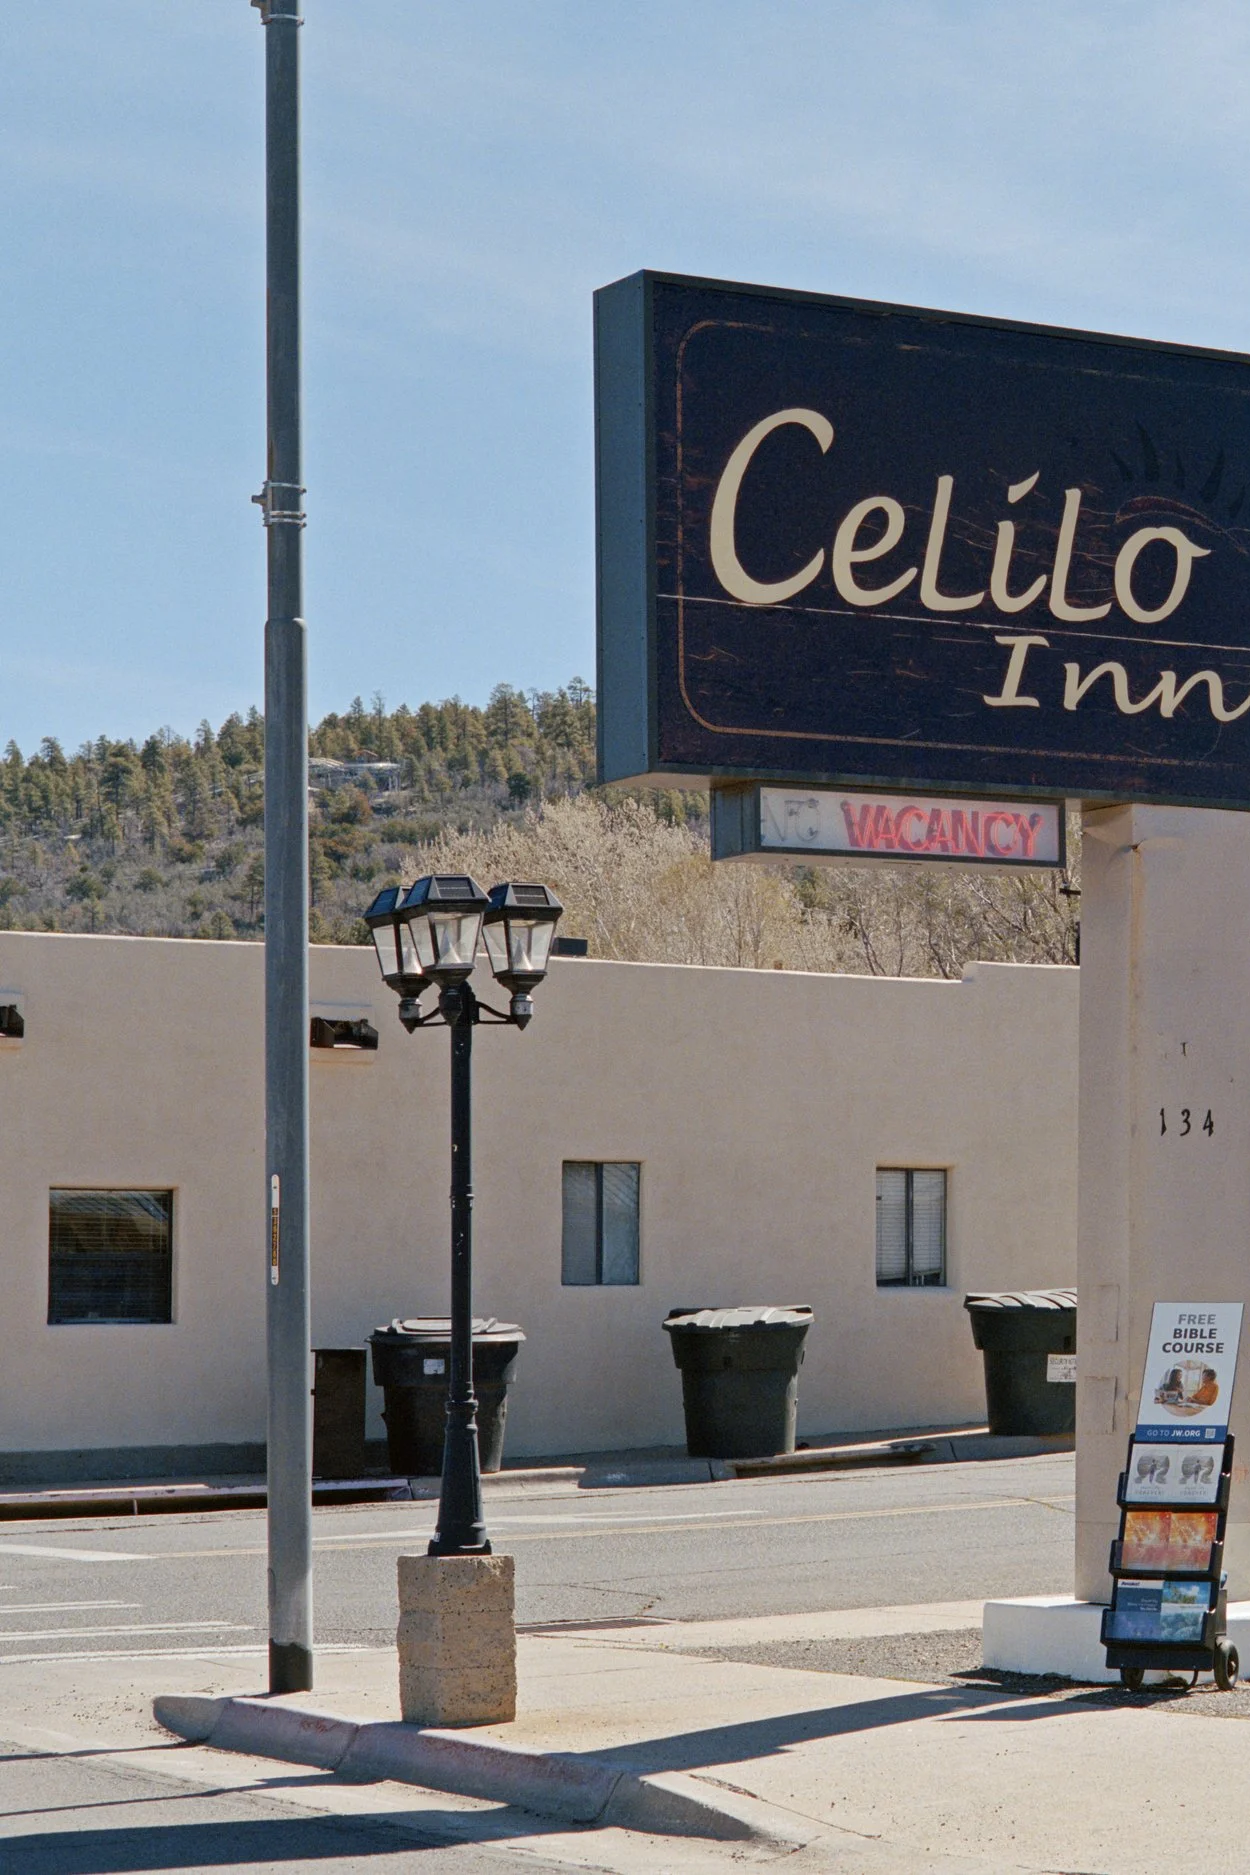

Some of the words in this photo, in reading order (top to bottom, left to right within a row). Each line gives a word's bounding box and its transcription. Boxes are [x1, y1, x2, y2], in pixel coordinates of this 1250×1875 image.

[710, 407, 1211, 624] Celilo
[840, 799, 1044, 858] VACANCY
[1177, 1313, 1217, 1325] FREE
[1172, 1328, 1218, 1339] BIBLE
[1161, 1342, 1224, 1354] COURSE
[1146, 1429, 1158, 1437] GO
[1160, 1429, 1170, 1437] TO
[1171, 1429, 1201, 1437] JW.ORG
